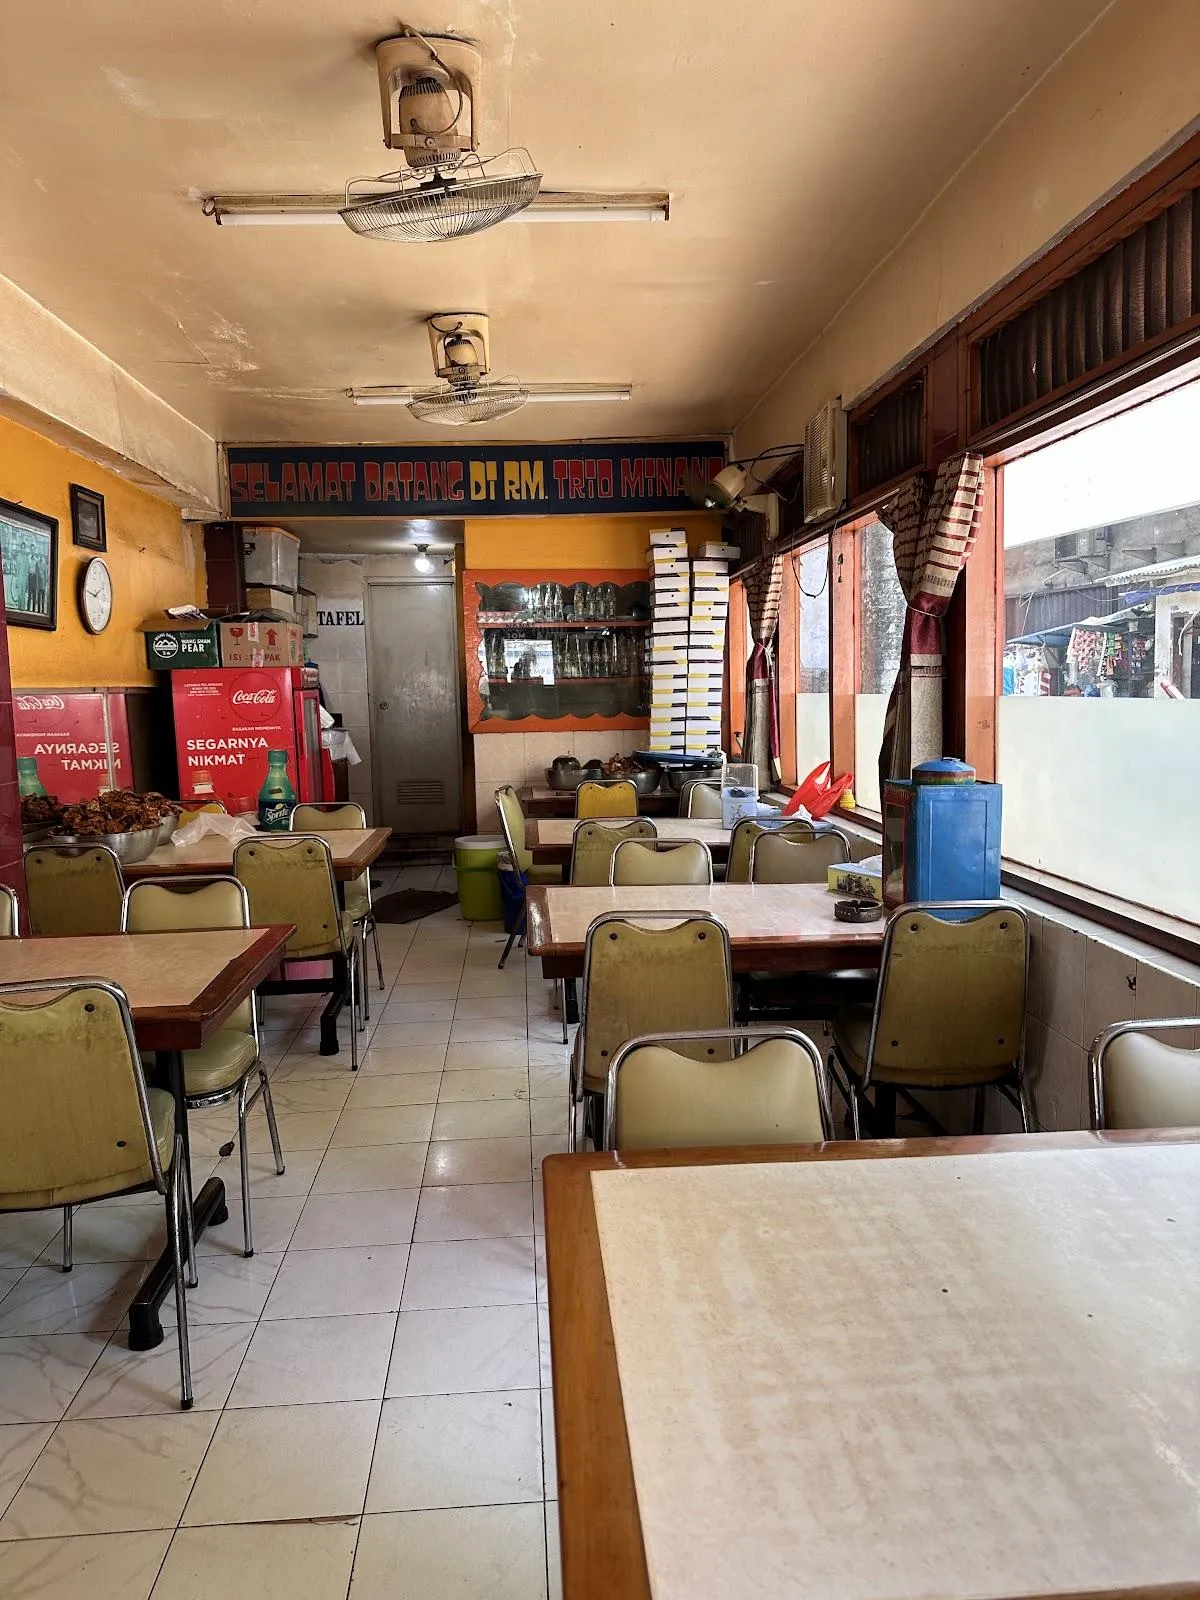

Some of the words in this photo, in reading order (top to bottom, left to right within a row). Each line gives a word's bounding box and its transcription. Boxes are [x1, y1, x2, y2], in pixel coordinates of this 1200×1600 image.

[230, 462, 356, 502] SELAMAT
[363, 461, 465, 501] DATANG
[469, 460, 498, 500] DI
[503, 459, 548, 500] RM.
[553, 458, 613, 499] TRIO
[316, 611, 364, 626] TAFEL
[181, 643, 205, 653] PEAR
[233, 689, 277, 704] Coca-Cola
[186, 738, 268, 750] SEGARNYA
[188, 754, 245, 766] NIKMAT
[266, 807, 290, 822] Sprite
